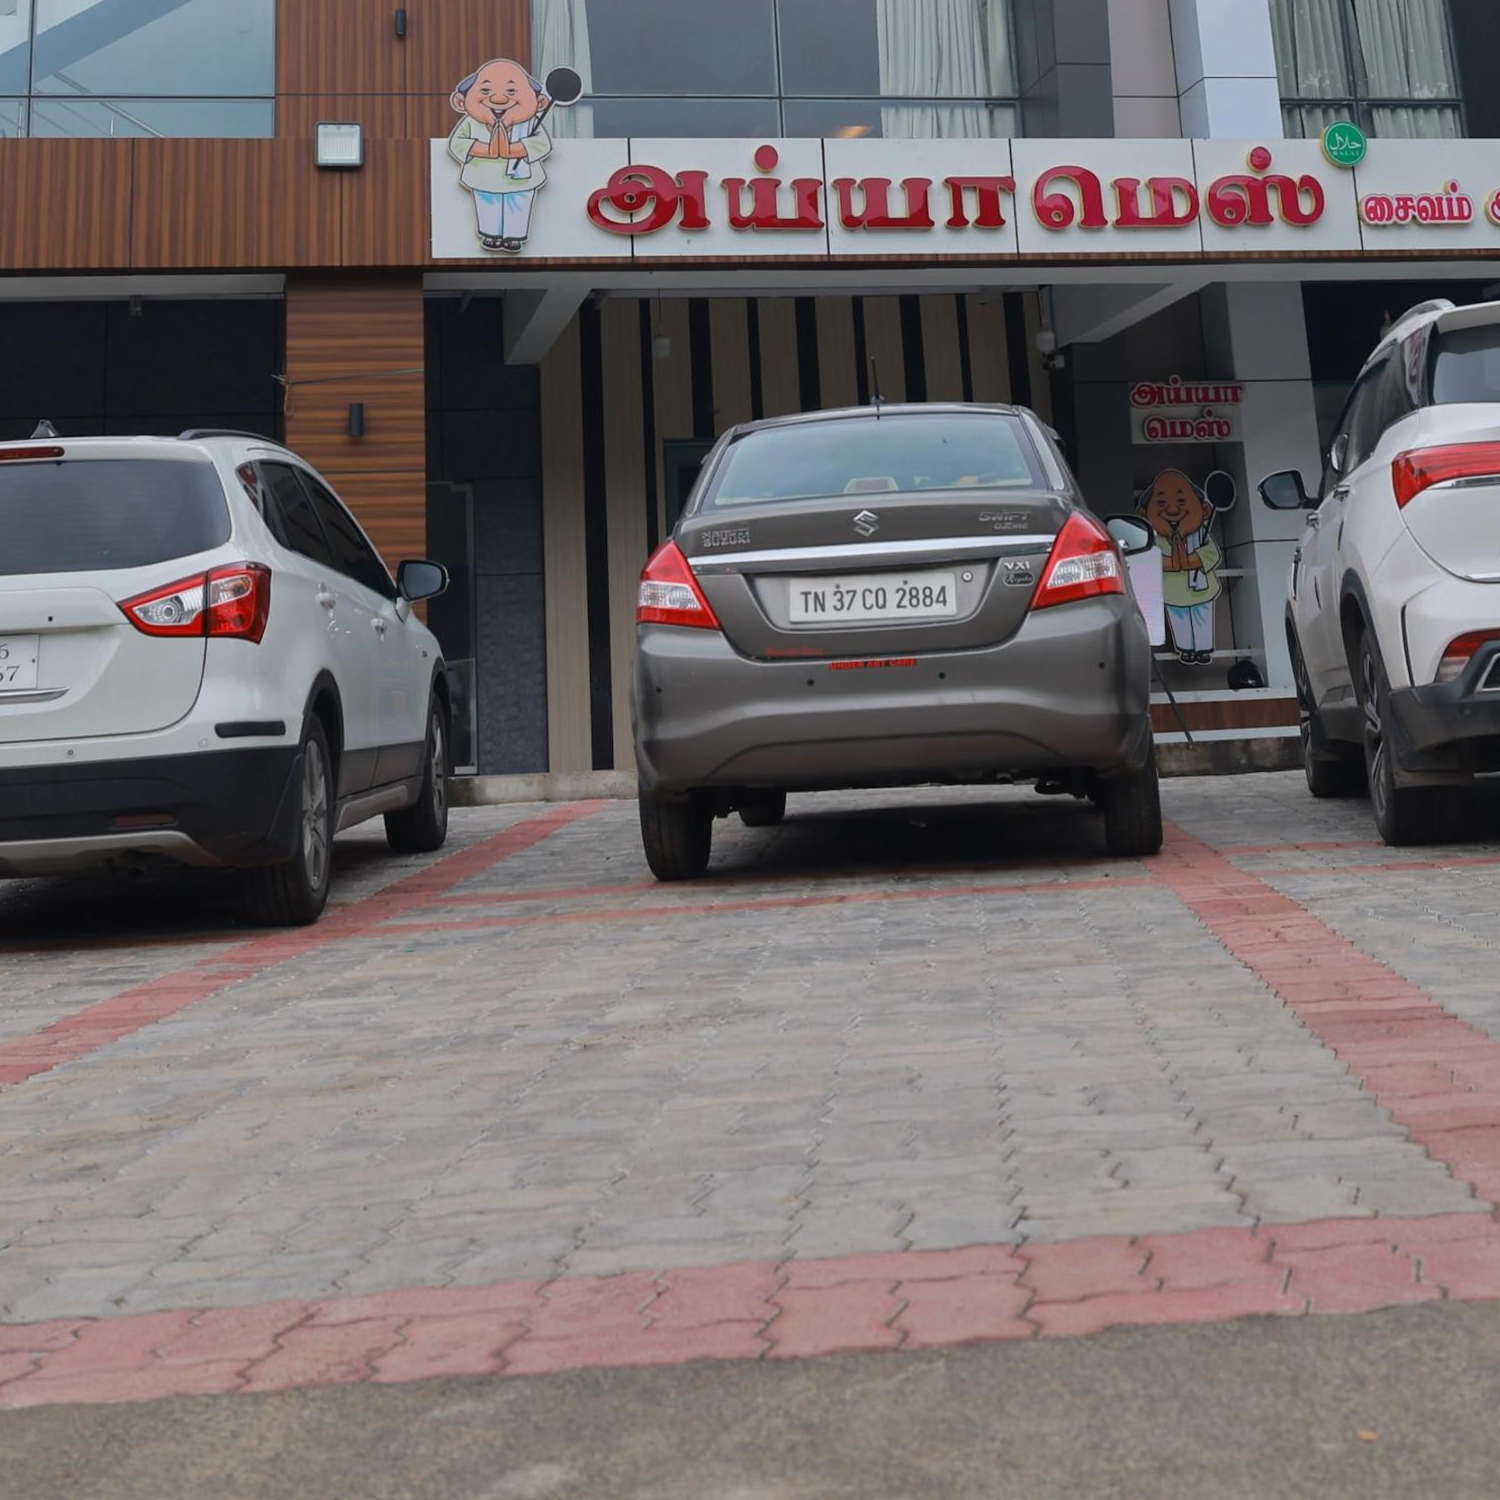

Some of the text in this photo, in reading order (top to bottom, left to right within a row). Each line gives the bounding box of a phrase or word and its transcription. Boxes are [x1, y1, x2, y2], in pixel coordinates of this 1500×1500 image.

[586, 144, 1326, 235] அய்யா மெஸ்
[1362, 179, 1474, 223] சைவம்
[1130, 375, 1244, 408] அய்யா
[1144, 407, 1232, 441] மெஸ்
[978, 510, 1033, 521] SWIFT
[800, 585, 948, 613] TN 37 CQ 2884
